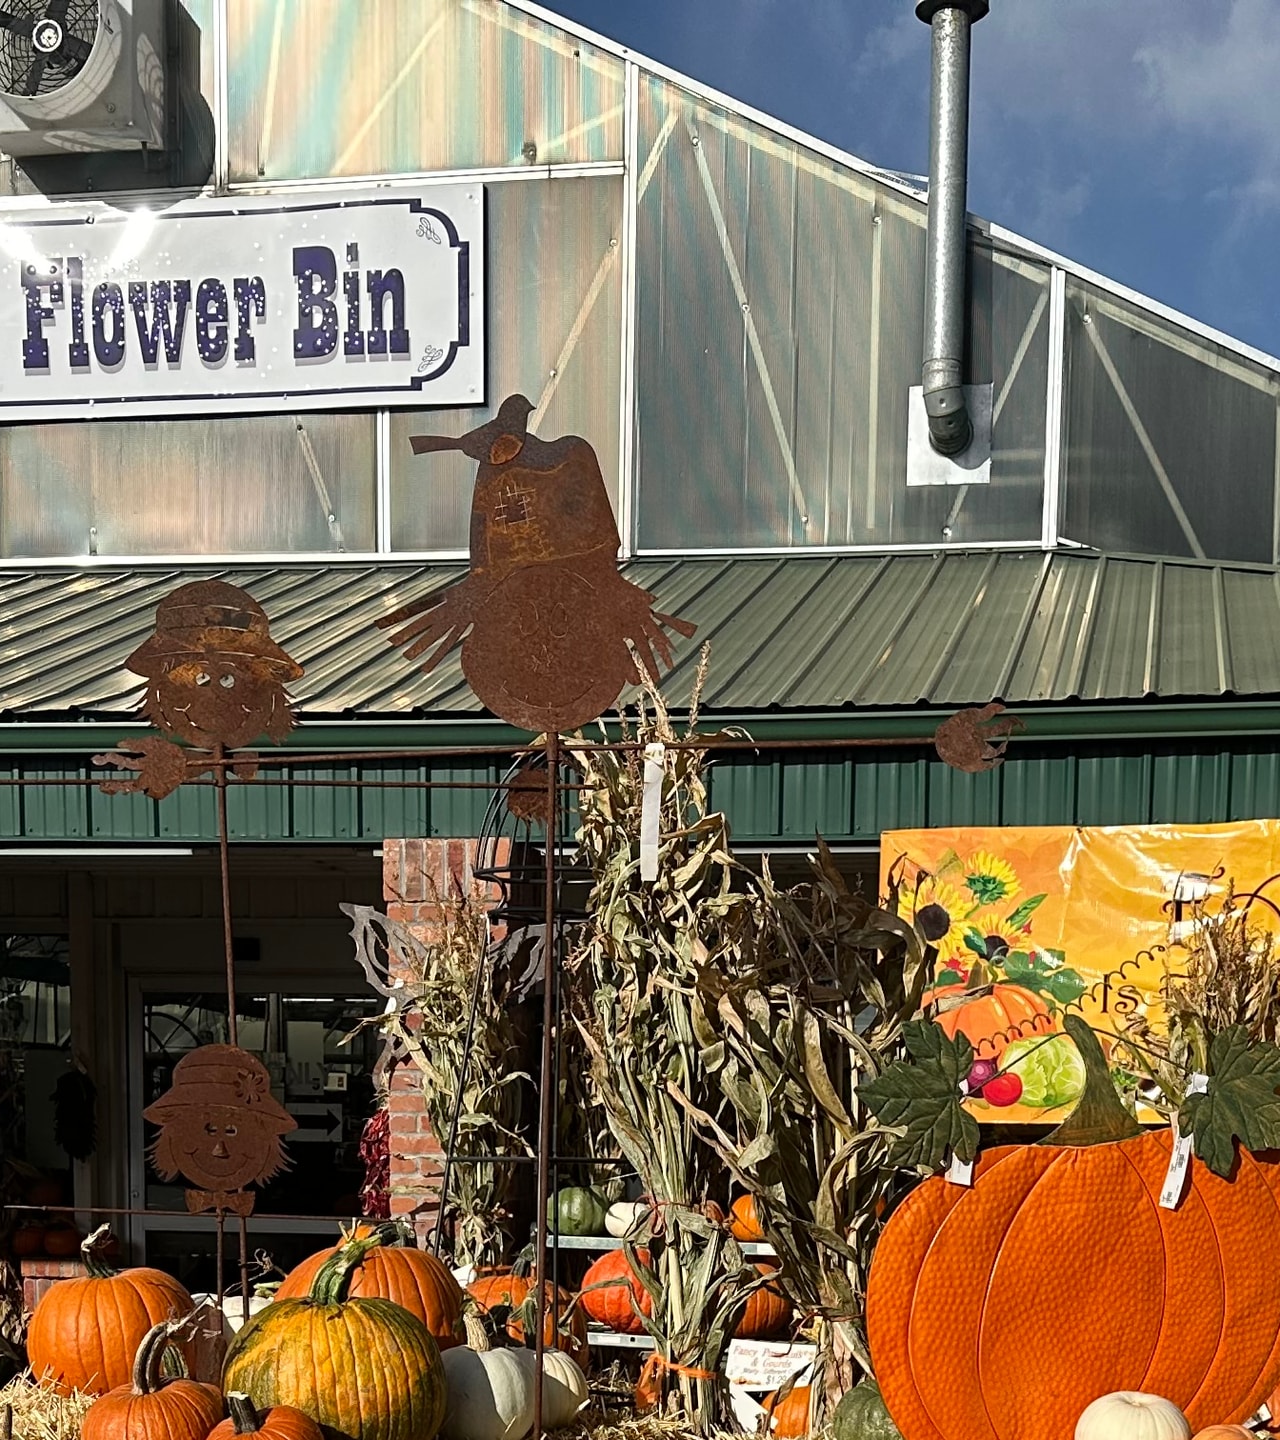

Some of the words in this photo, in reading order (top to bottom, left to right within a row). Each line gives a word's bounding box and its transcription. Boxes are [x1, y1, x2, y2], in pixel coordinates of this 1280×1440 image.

[20, 256, 266, 368] Flower
[292, 242, 410, 357] Bin
[1100, 973, 1139, 1014] Is
